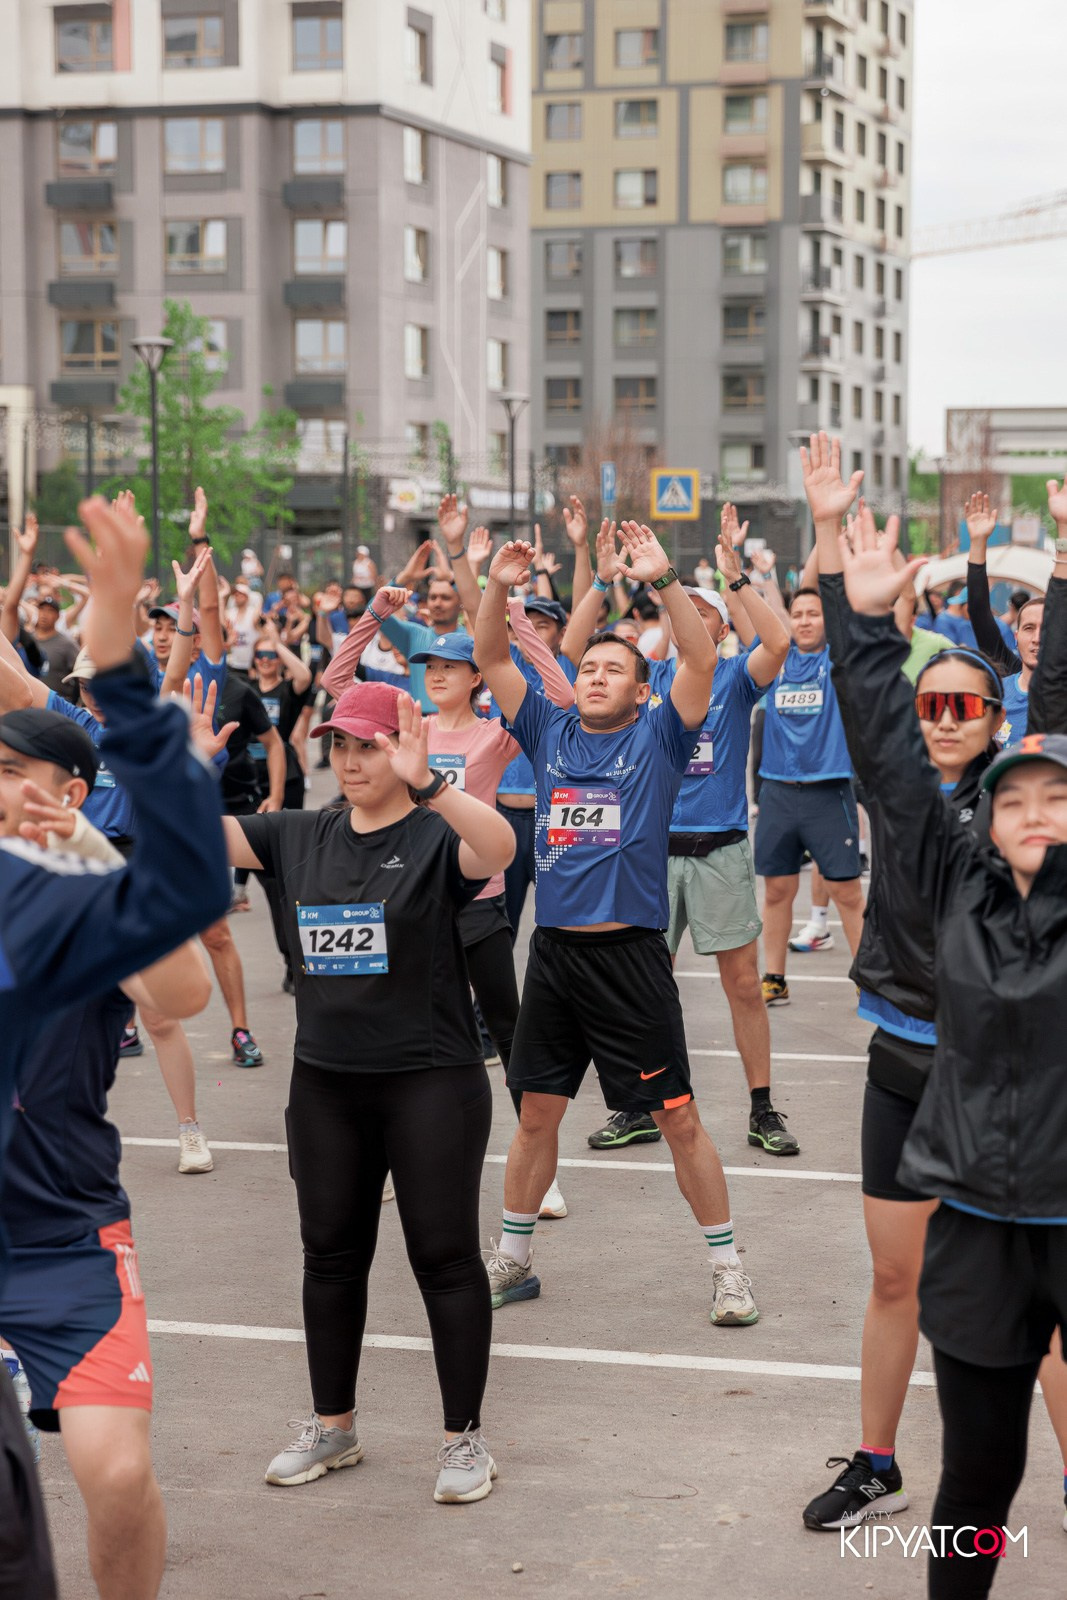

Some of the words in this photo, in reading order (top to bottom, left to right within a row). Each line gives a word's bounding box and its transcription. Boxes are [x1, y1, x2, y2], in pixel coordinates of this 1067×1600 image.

[781, 693, 817, 705] 1489
[560, 807, 604, 827] 164
[301, 911, 306, 920] 5
[307, 911, 319, 920] KM
[309, 927, 374, 953] 1242
